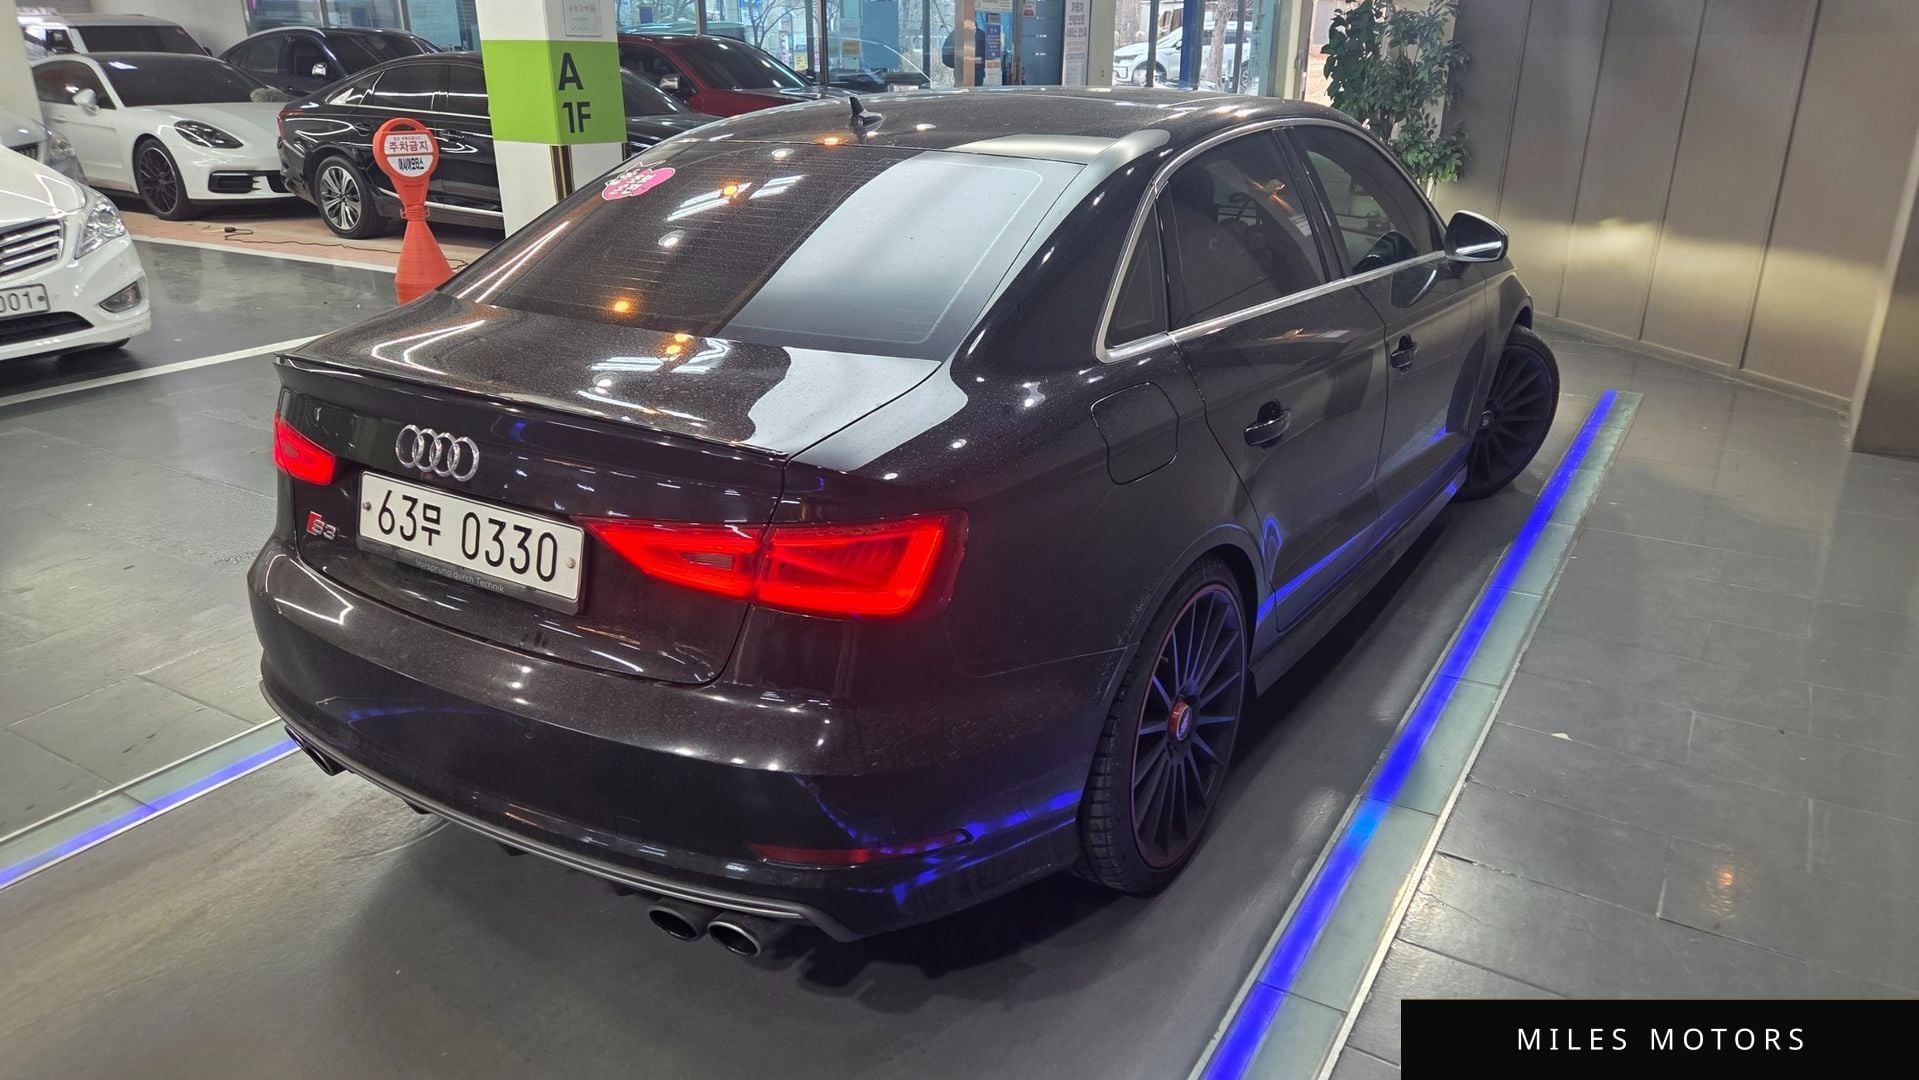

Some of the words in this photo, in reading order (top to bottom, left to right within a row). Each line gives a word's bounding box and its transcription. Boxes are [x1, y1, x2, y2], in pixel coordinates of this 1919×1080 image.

[558, 52, 584, 91] A
[562, 101, 592, 133] 1F
[389, 140, 428, 152] 주차금지
[307, 512, 337, 541] S3
[378, 489, 441, 546] 63무
[461, 511, 558, 582] 0330
[415, 558, 453, 578] Vorsprung
[452, 570, 475, 584] durch
[475, 576, 505, 593] Technik
